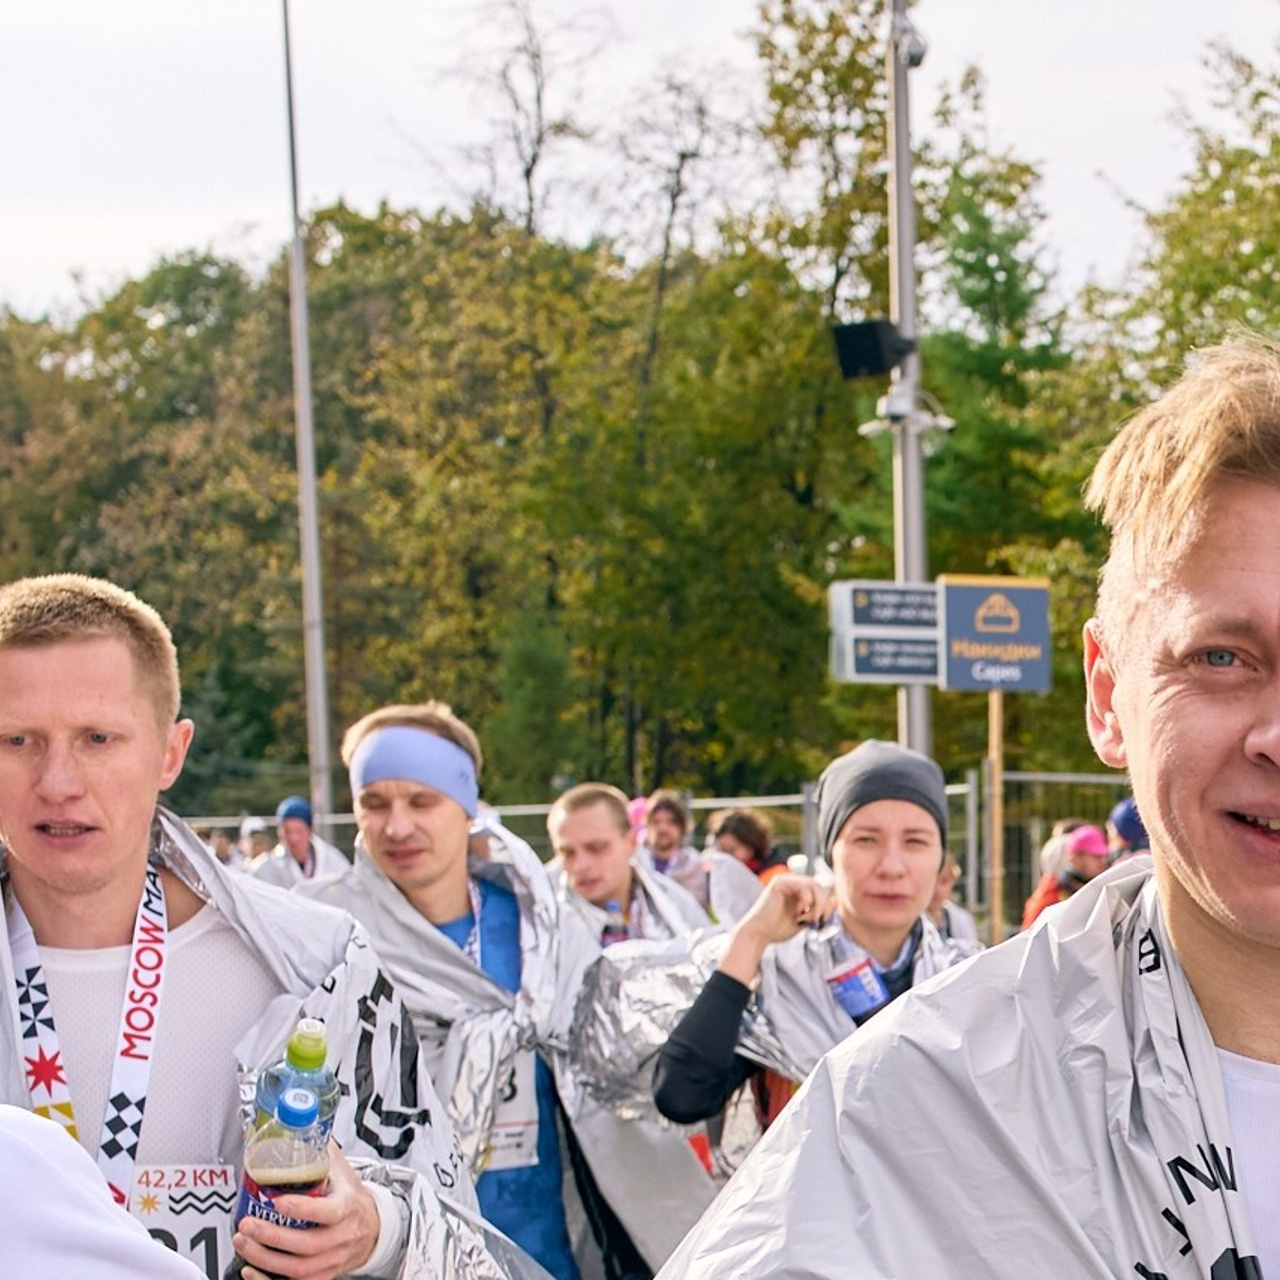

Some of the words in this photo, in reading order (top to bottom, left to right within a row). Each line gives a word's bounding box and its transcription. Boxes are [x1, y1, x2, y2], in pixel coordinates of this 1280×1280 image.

[120, 915, 165, 1061] MOSCOW
[138, 1169, 187, 1191] 42,2
[193, 1168, 229, 1187] KM
